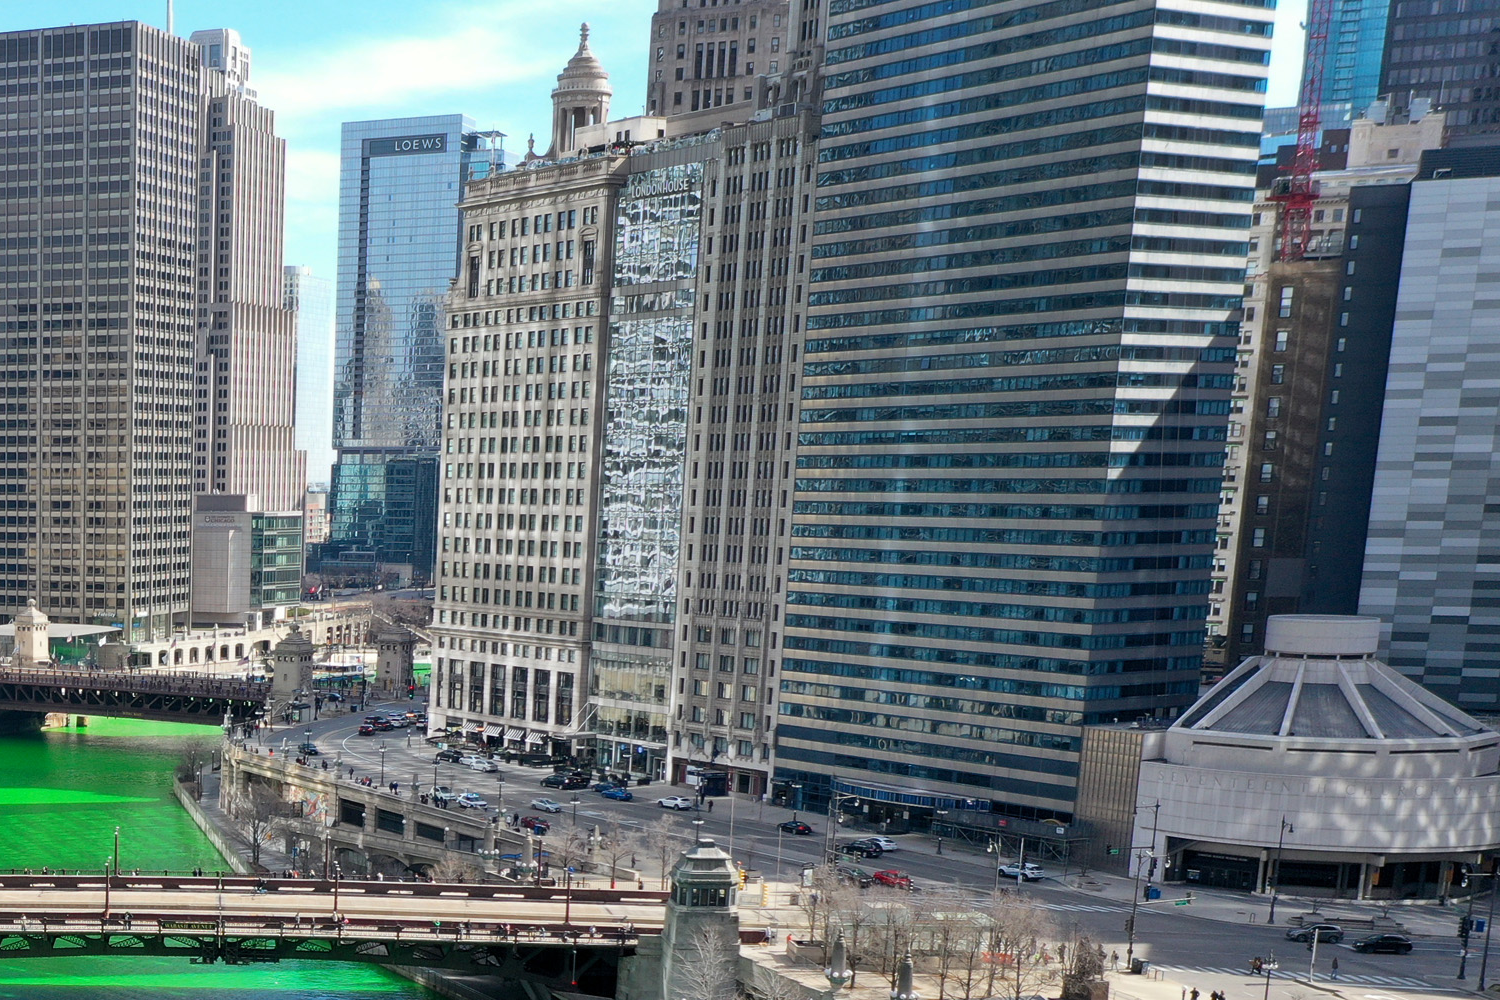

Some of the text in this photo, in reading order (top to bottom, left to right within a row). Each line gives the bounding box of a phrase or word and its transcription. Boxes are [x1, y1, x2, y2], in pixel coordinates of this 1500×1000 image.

[395, 138, 442, 151] LOEWS
[1158, 770, 1326, 793] SEVENTEENTH
[1345, 784, 1438, 797] CHURCH
